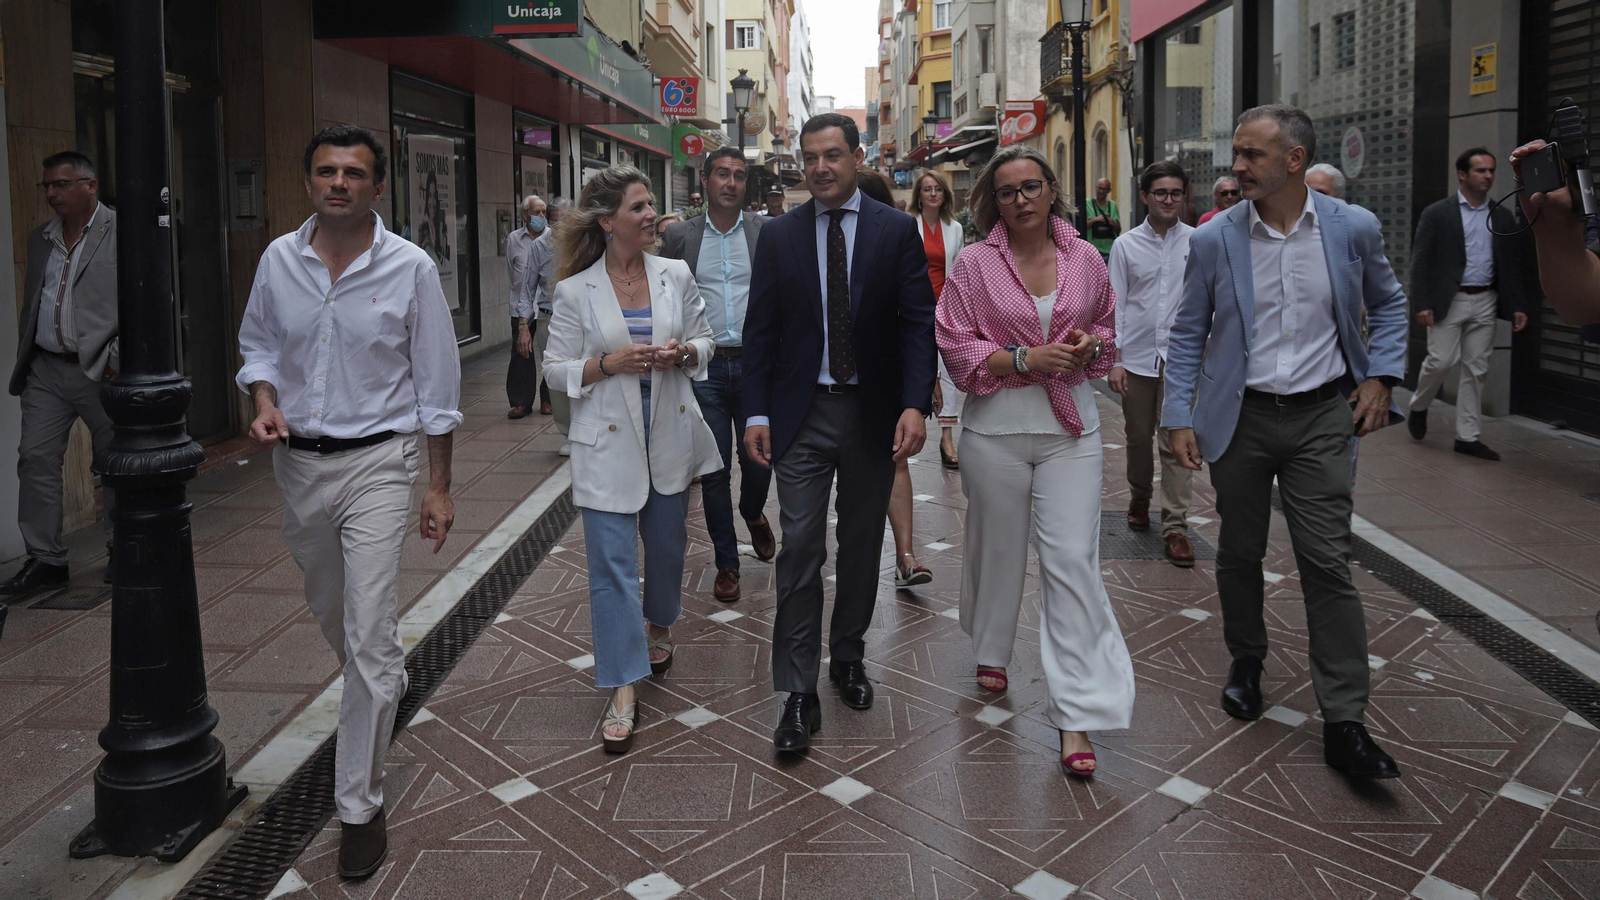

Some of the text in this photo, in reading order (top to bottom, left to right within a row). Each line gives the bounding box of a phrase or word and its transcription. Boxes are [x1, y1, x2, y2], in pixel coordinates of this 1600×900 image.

[508, 2, 562, 20] Unicaja
[600, 53, 620, 88] Unicaja
[415, 152, 449, 176] SOMOS MÁS
[525, 170, 537, 187] SOMOS
